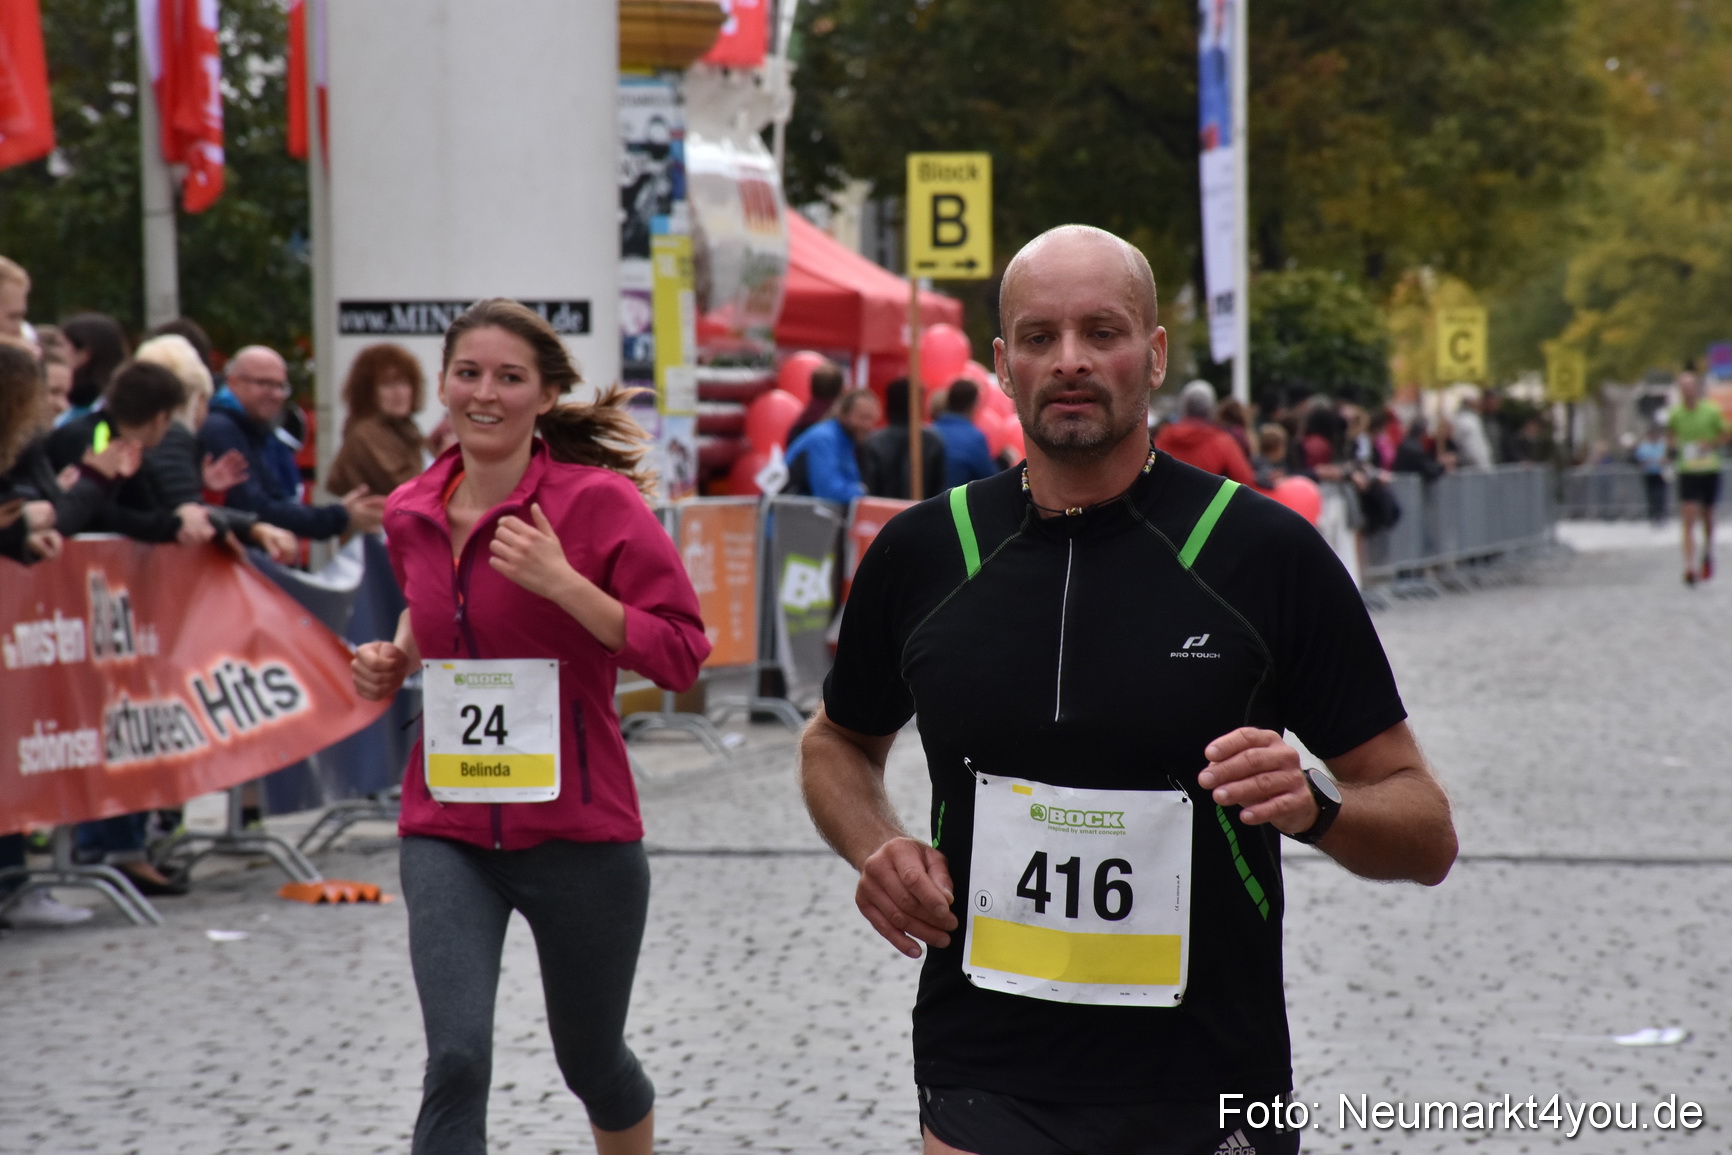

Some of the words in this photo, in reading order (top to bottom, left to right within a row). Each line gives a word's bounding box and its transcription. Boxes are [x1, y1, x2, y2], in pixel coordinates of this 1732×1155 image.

[918, 161, 979, 182] Block
[933, 194, 968, 248] B
[1450, 331, 1472, 362] C
[467, 672, 513, 685] BOCK
[194, 662, 302, 737] Hits
[460, 704, 508, 745] 24
[461, 762, 511, 777] Belinda
[1048, 806, 1125, 829] BOCK
[1048, 825, 1069, 833] inspired
[1016, 850, 1134, 921] 416
[980, 895, 987, 907] D
